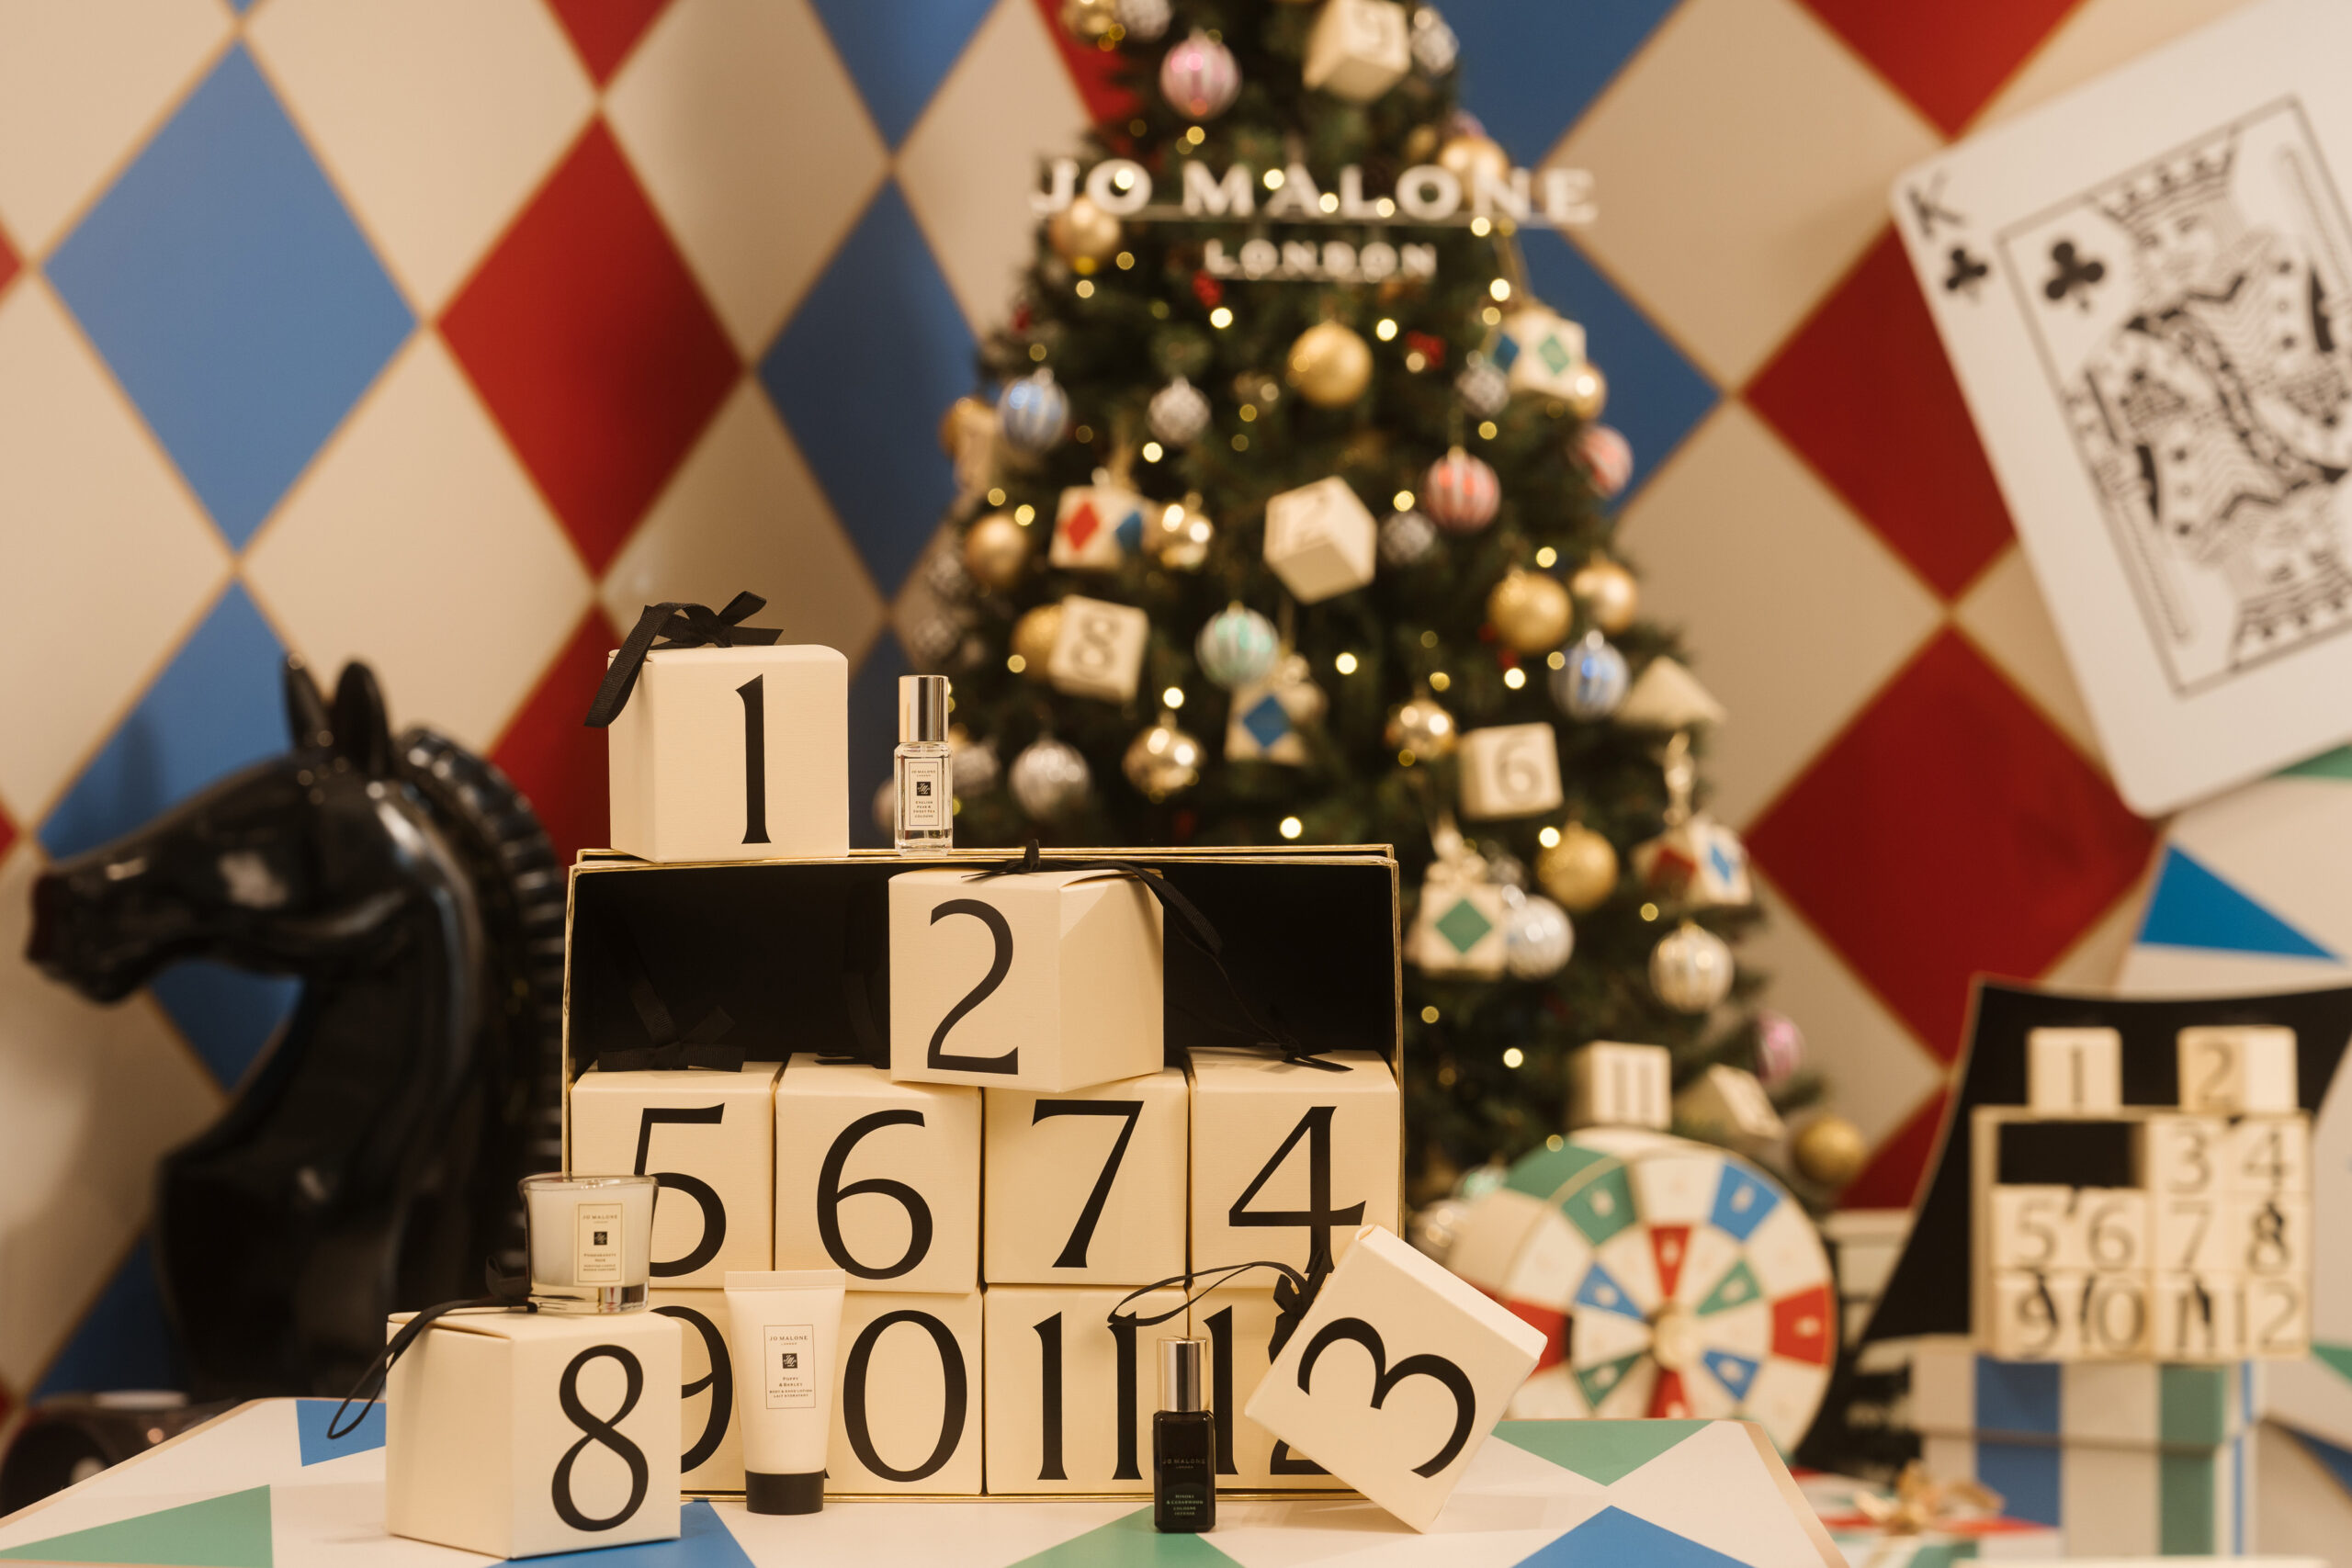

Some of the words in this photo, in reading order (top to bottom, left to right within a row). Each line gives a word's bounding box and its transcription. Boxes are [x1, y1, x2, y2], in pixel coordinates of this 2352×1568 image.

[1029, 156, 1153, 220] JO
[1182, 160, 1599, 224] MALONE
[1905, 170, 1964, 238] K
[1204, 238, 1438, 276] LONDON
[1069, 611, 1121, 682] 8
[735, 672, 773, 845] 1
[1493, 733, 1544, 806] 6
[926, 898, 1019, 1076] 2
[2069, 1043, 2086, 1112] 1
[2195, 1042, 2234, 1105] 2
[632, 1102, 727, 1279] 5
[816, 1108, 933, 1280] 6
[1031, 1099, 1145, 1269] 7
[1228, 1106, 1367, 1274] 4
[2167, 1124, 2212, 1194] 3
[2241, 1128, 2295, 1195] 4
[2017, 1198, 2059, 1269] 5
[2086, 1199, 2136, 1271] 6
[2169, 1201, 2213, 1272] 7
[2247, 1201, 2291, 1277] 8
[2016, 1279, 2060, 1359] 9
[2233, 1281, 2301, 1350] 12
[1033, 1312, 1144, 1481] 11
[1297, 1317, 1476, 1479] 3
[551, 1344, 649, 1532] 8
